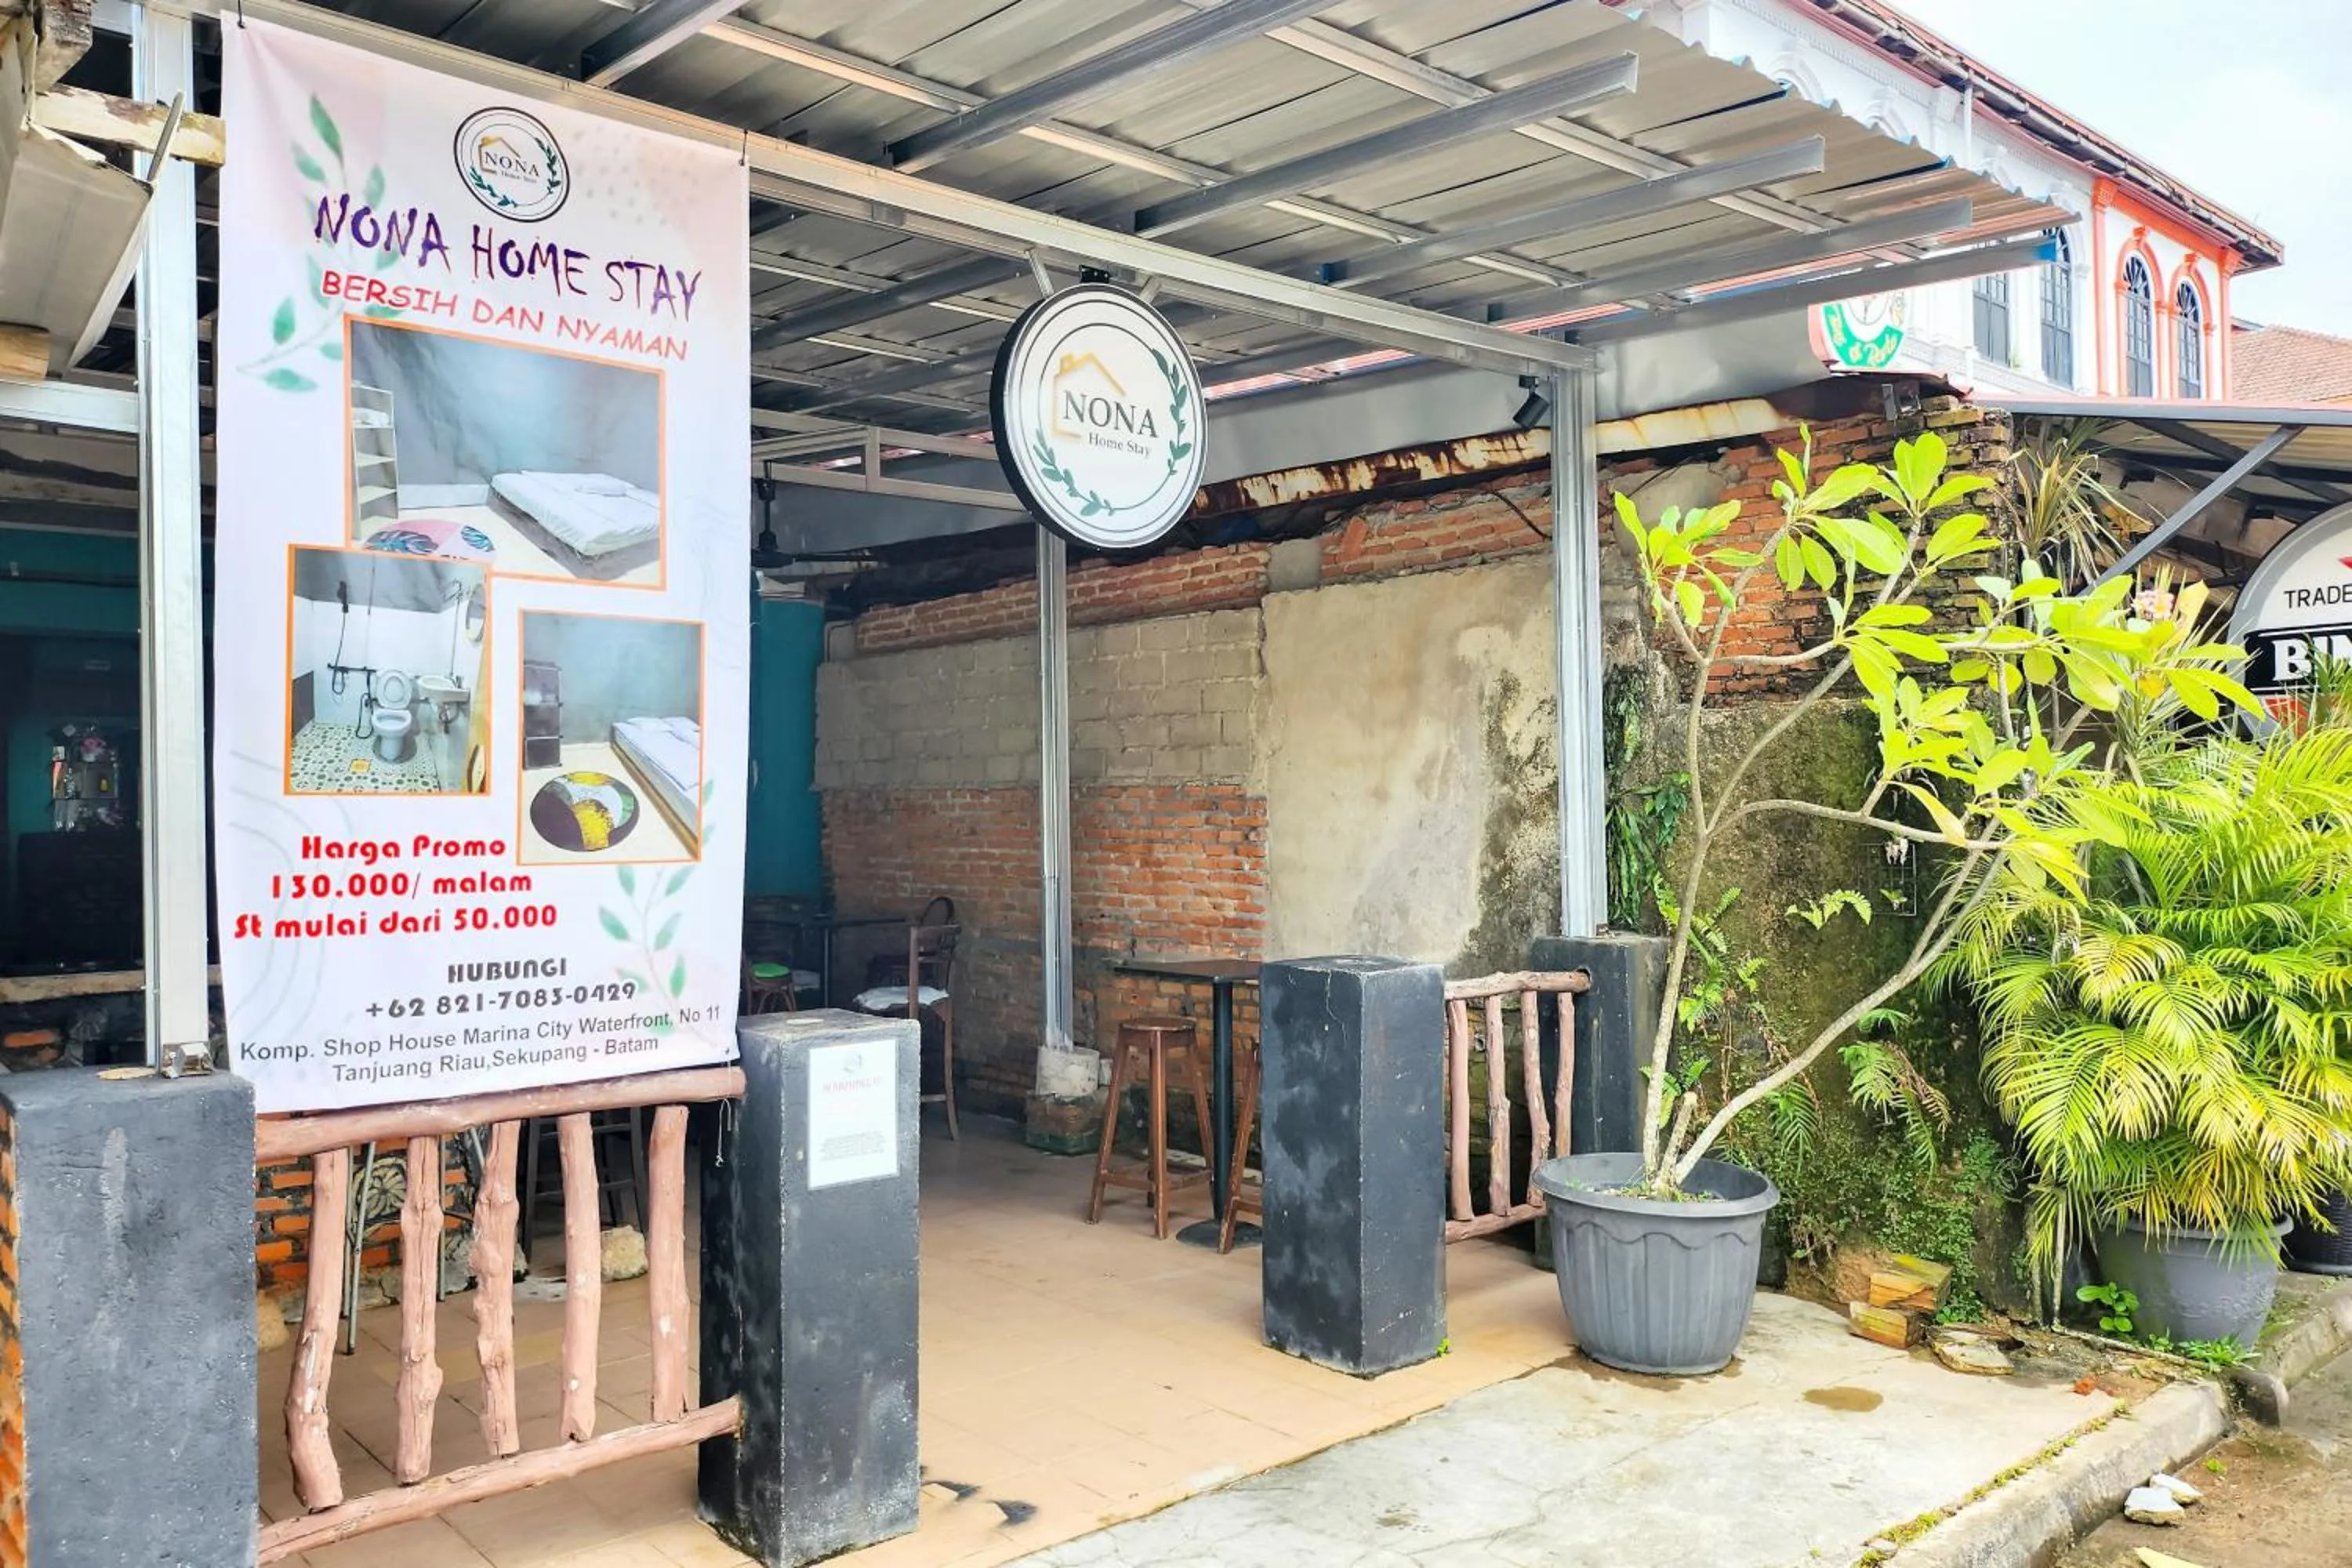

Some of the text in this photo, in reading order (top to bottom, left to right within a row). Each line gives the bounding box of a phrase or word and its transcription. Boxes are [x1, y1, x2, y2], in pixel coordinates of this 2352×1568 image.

[485, 151, 540, 178] NONA
[314, 194, 702, 321] NONA HOME STAY
[322, 270, 687, 361] BERSIH DAN NYAMAN
[1063, 390, 1159, 438] NONA
[1089, 433, 1152, 459] Home Stay
[2283, 583, 2352, 609] TRADE
[302, 835, 506, 866] Harga Promo
[433, 870, 532, 894] malam
[234, 904, 557, 938] St mulai dari 50.000
[448, 957, 568, 984] HUBUNGI
[365, 982, 637, 1018] +62 821-7083-0429
[240, 1005, 720, 1062] Komp. Shop House Marina City Waterfront, No 11
[333, 1061, 432, 1083] Tanjuang
[605, 1036, 659, 1054] Batam
